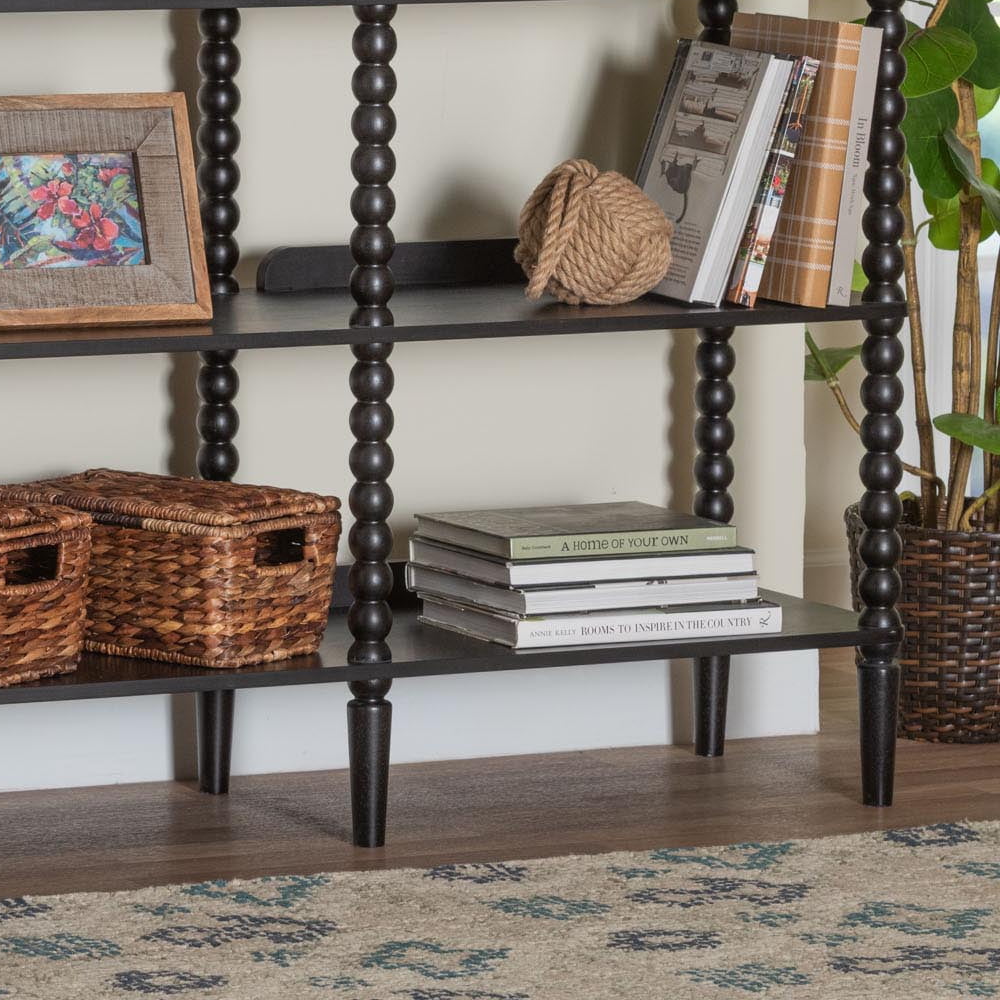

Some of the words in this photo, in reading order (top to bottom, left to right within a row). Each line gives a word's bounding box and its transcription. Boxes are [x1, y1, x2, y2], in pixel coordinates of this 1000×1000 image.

[857, 118, 868, 129] In
[852, 132, 866, 168] Bloom
[561, 541, 570, 552] A
[611, 538, 625, 549] OF
[661, 535, 689, 546] OWN
[529, 630, 553, 638] ANNIE
[580, 625, 615, 636] ROOMS
[617, 624, 631, 634] TO
[634, 621, 673, 633] INSPIRE
[674, 620, 685, 631] IN
[686, 619, 706, 630] THE
[706, 616, 753, 629] COUNTRY
